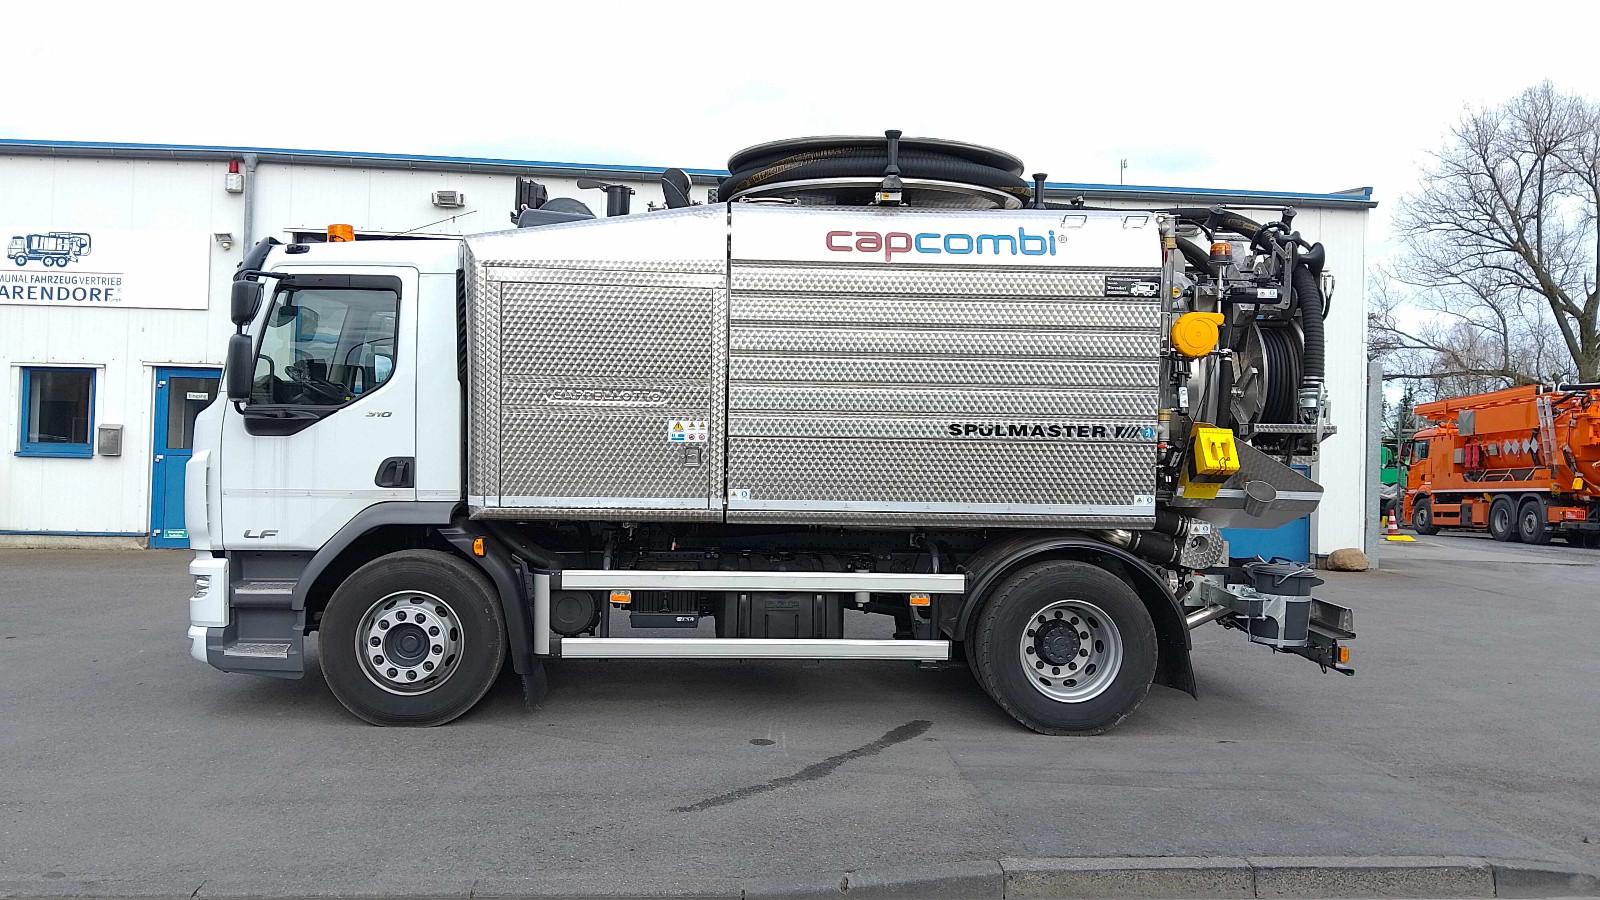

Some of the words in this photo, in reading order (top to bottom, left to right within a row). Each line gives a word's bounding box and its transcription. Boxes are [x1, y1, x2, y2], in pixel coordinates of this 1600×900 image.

[826, 227, 1056, 263] capcombi
[31, 275, 78, 285] FAHRZEUG
[79, 276, 122, 286] VERTRIEB
[0, 285, 114, 301] ARENDORF
[243, 529, 279, 539] LF
